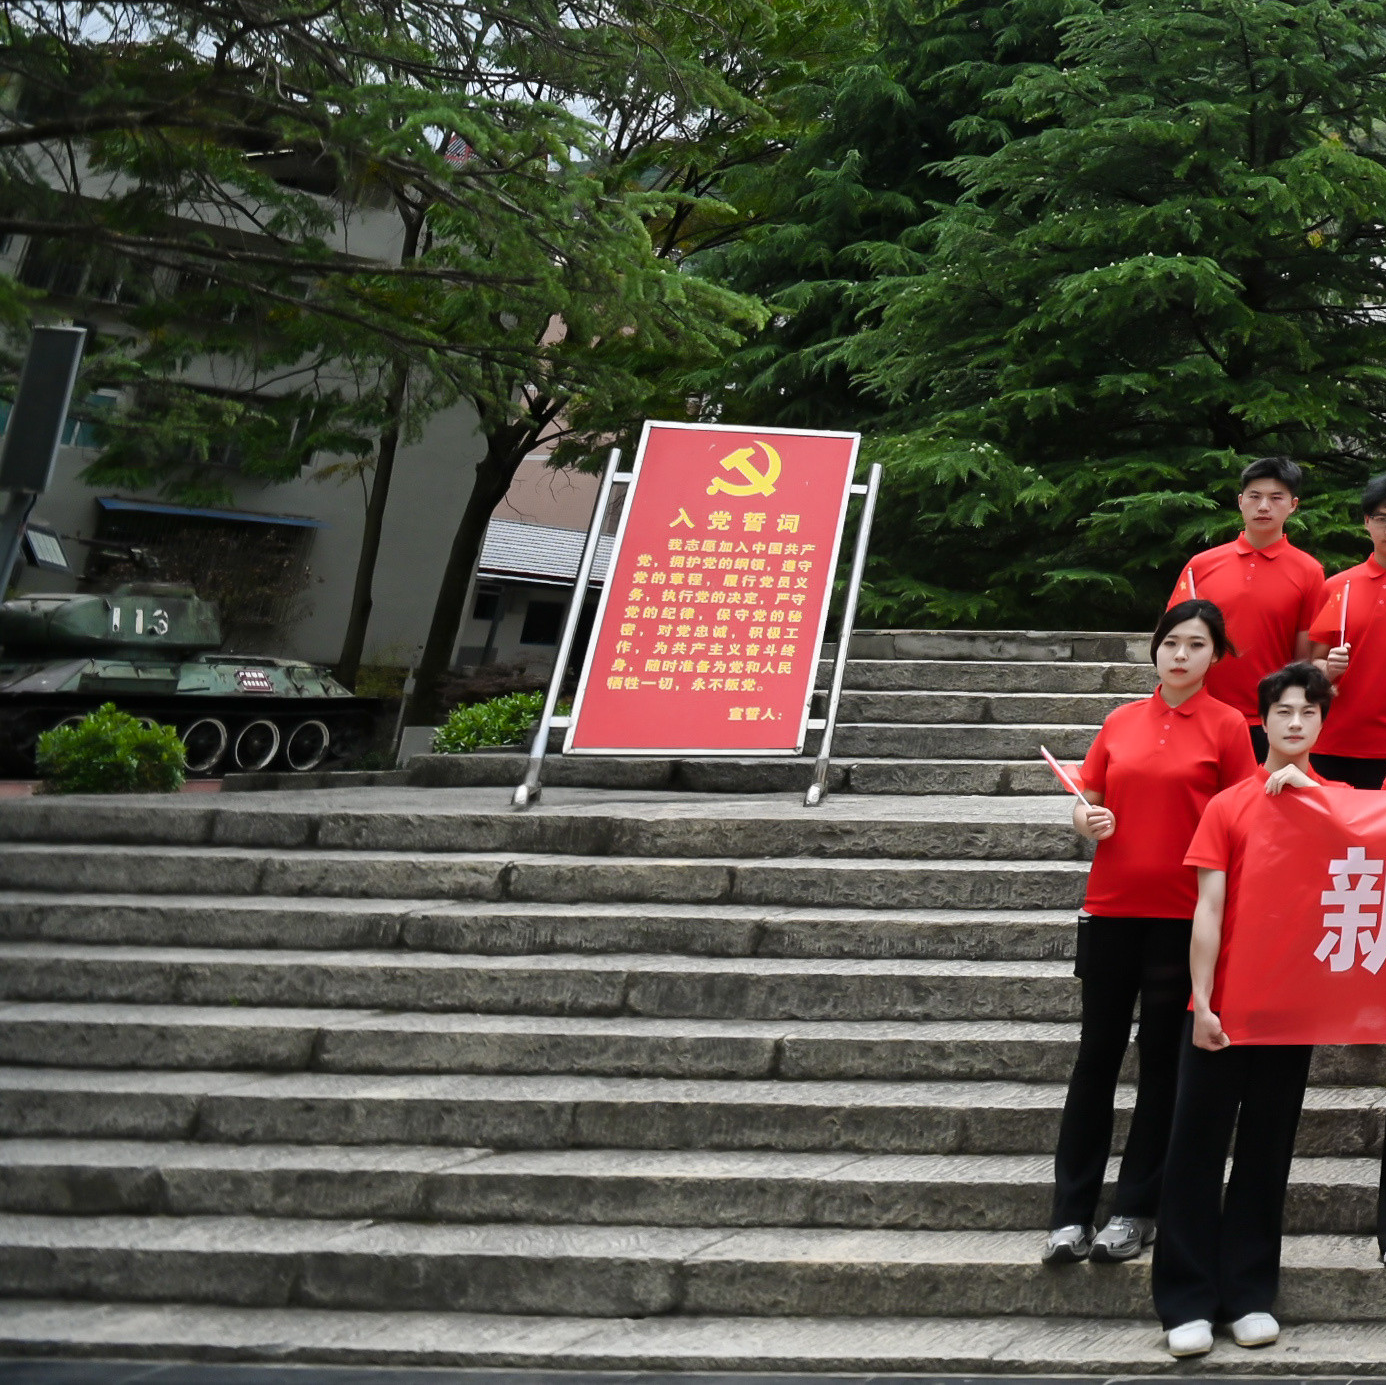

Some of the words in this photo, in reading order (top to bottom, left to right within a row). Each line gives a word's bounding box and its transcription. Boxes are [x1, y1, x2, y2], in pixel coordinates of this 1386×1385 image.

[669, 507, 801, 534] 入党誓词
[667, 538, 816, 556] 我志愿加入中国共产
[636, 554, 813, 573] 党，拥护党的纲领，遵守
[632, 571, 809, 589] 党的章程，履行党员义
[628, 588, 806, 606] 务，执行党的决定，严守
[623, 605, 803, 623] 党的纪律，保守党的秘
[619, 622, 799, 640] 密，对党忠诚，积极工
[615, 640, 796, 657] 作，为共产主义奋斗终
[610, 658, 793, 675] 身，随时准备为党和人民
[606, 675, 763, 692] 牺牲一切，永不叛党。
